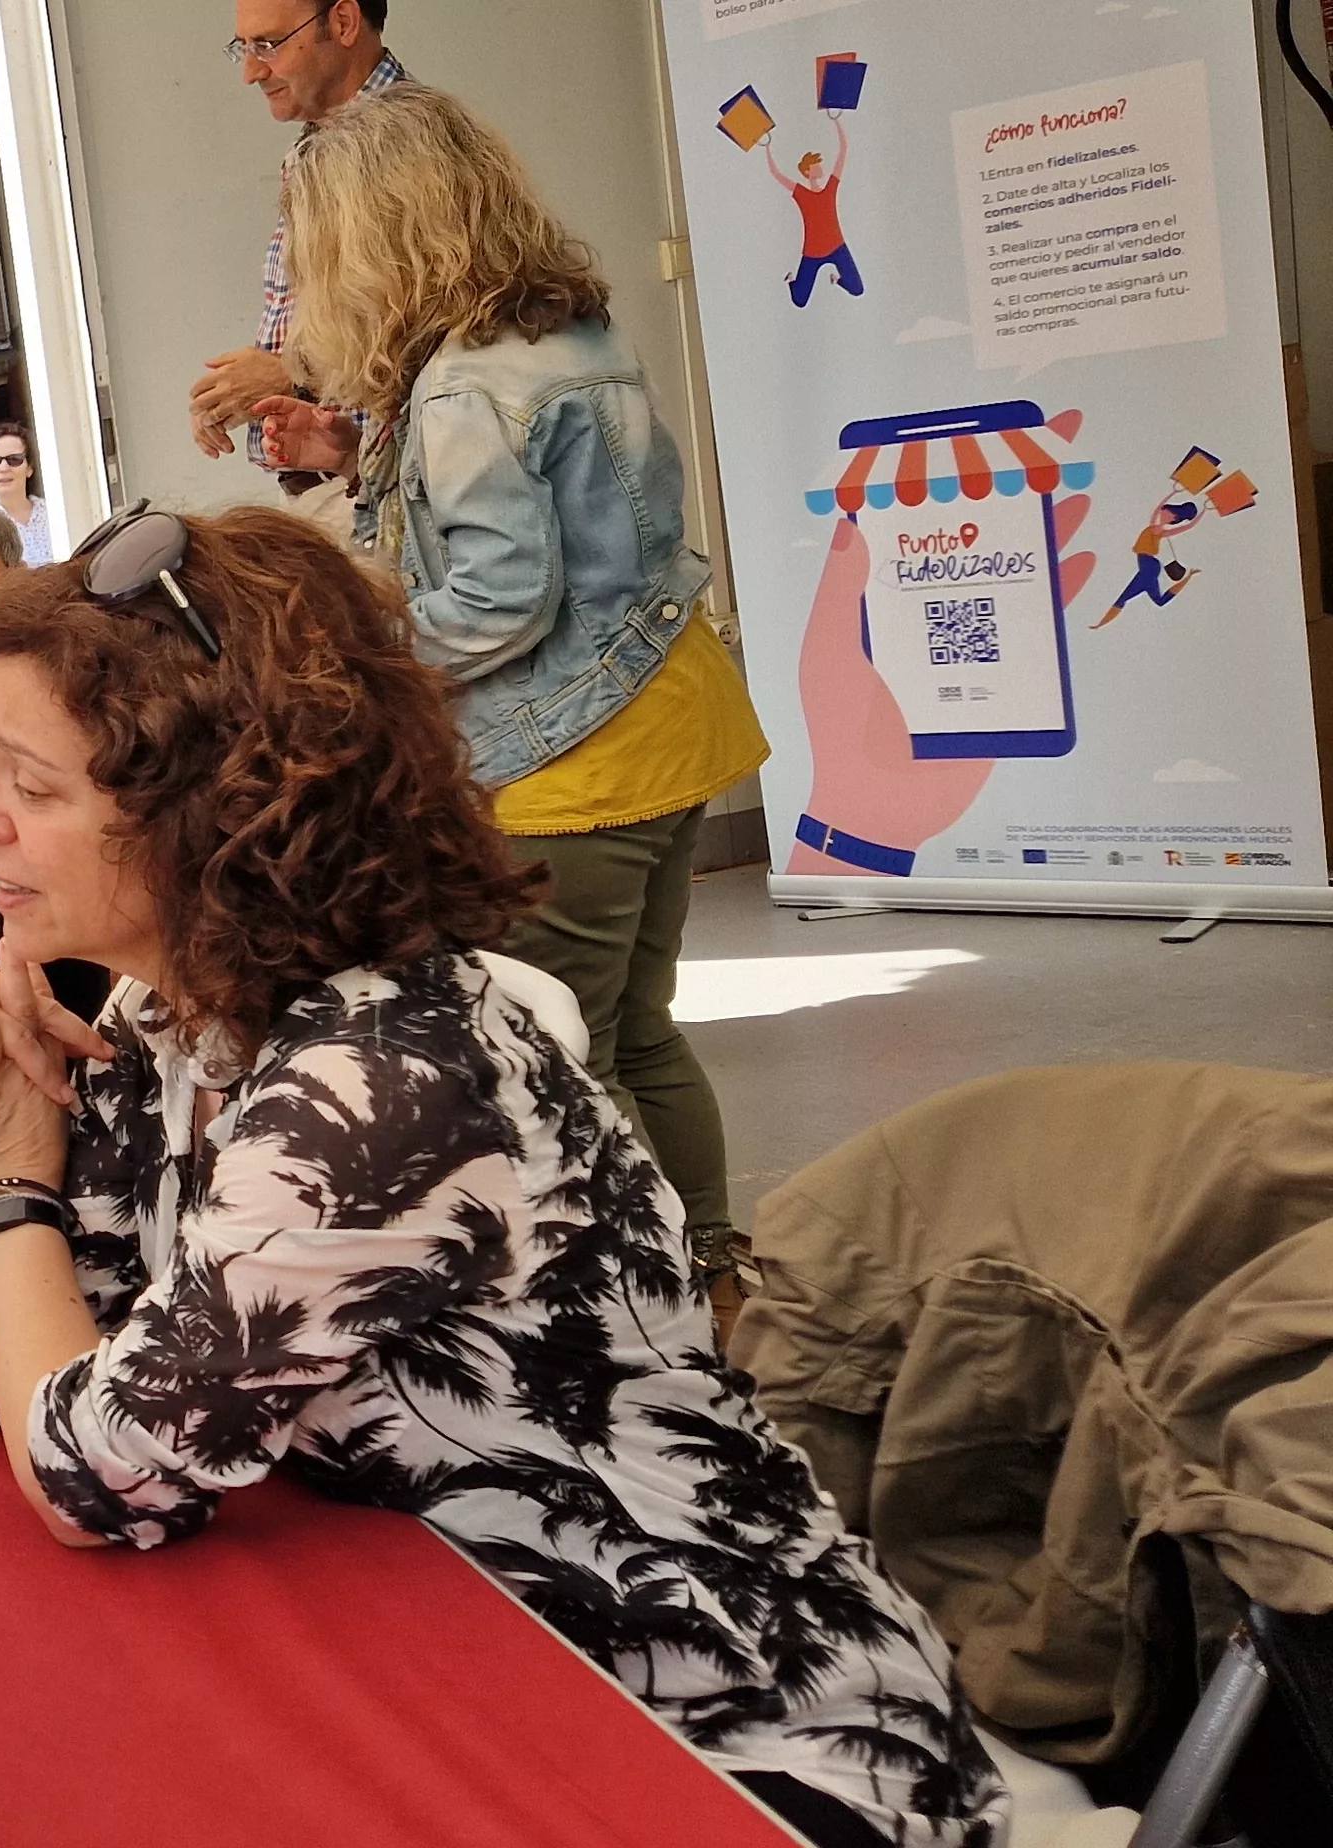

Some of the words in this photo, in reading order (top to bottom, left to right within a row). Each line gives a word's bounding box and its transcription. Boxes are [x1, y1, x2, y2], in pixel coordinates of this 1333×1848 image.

[715, 4, 747, 19] bolso
[1040, 98, 1127, 137] funciona?
[997, 188, 1028, 202] Date
[1031, 184, 1049, 196] de
[1051, 179, 1077, 192] alta
[1079, 177, 1088, 189] y
[1091, 165, 1146, 184] Localiza
[1149, 161, 1171, 174] los
[1027, 162, 1044, 173] en
[984, 199, 1055, 219] comercios
[1058, 184, 1128, 206] adheridos
[985, 219, 1023, 234] zales.
[1002, 237, 1053, 254] Realizar
[1057, 232, 1083, 245] una
[1085, 223, 1138, 241] compra
[1142, 219, 1161, 231] en
[1164, 214, 1177, 226] el
[989, 252, 1052, 272] comercio
[1053, 250, 1062, 262] y
[1065, 243, 1100, 260] pedir
[1103, 240, 1116, 252] al
[1117, 229, 1187, 250] vendedor
[990, 274, 1017, 287] que
[1019, 264, 1070, 283] quieres
[1071, 252, 1138, 272] acumular
[1141, 245, 1185, 262] saldo.
[994, 308, 1030, 323] saldo
[1033, 293, 1117, 319] promocional
[1121, 291, 1152, 306] para
[1154, 284, 1191, 299] futu-
[1008, 294, 1021, 306] El
[1023, 285, 1087, 305] comercio
[1088, 282, 1103, 294] te
[1105, 271, 1166, 293] asignará
[1169, 270, 1189, 282] un
[996, 326, 1017, 337] ras
[1018, 316, 1081, 336] compras.
[897, 527, 961, 558] Punto
[1125, 826, 1140, 834] DE
